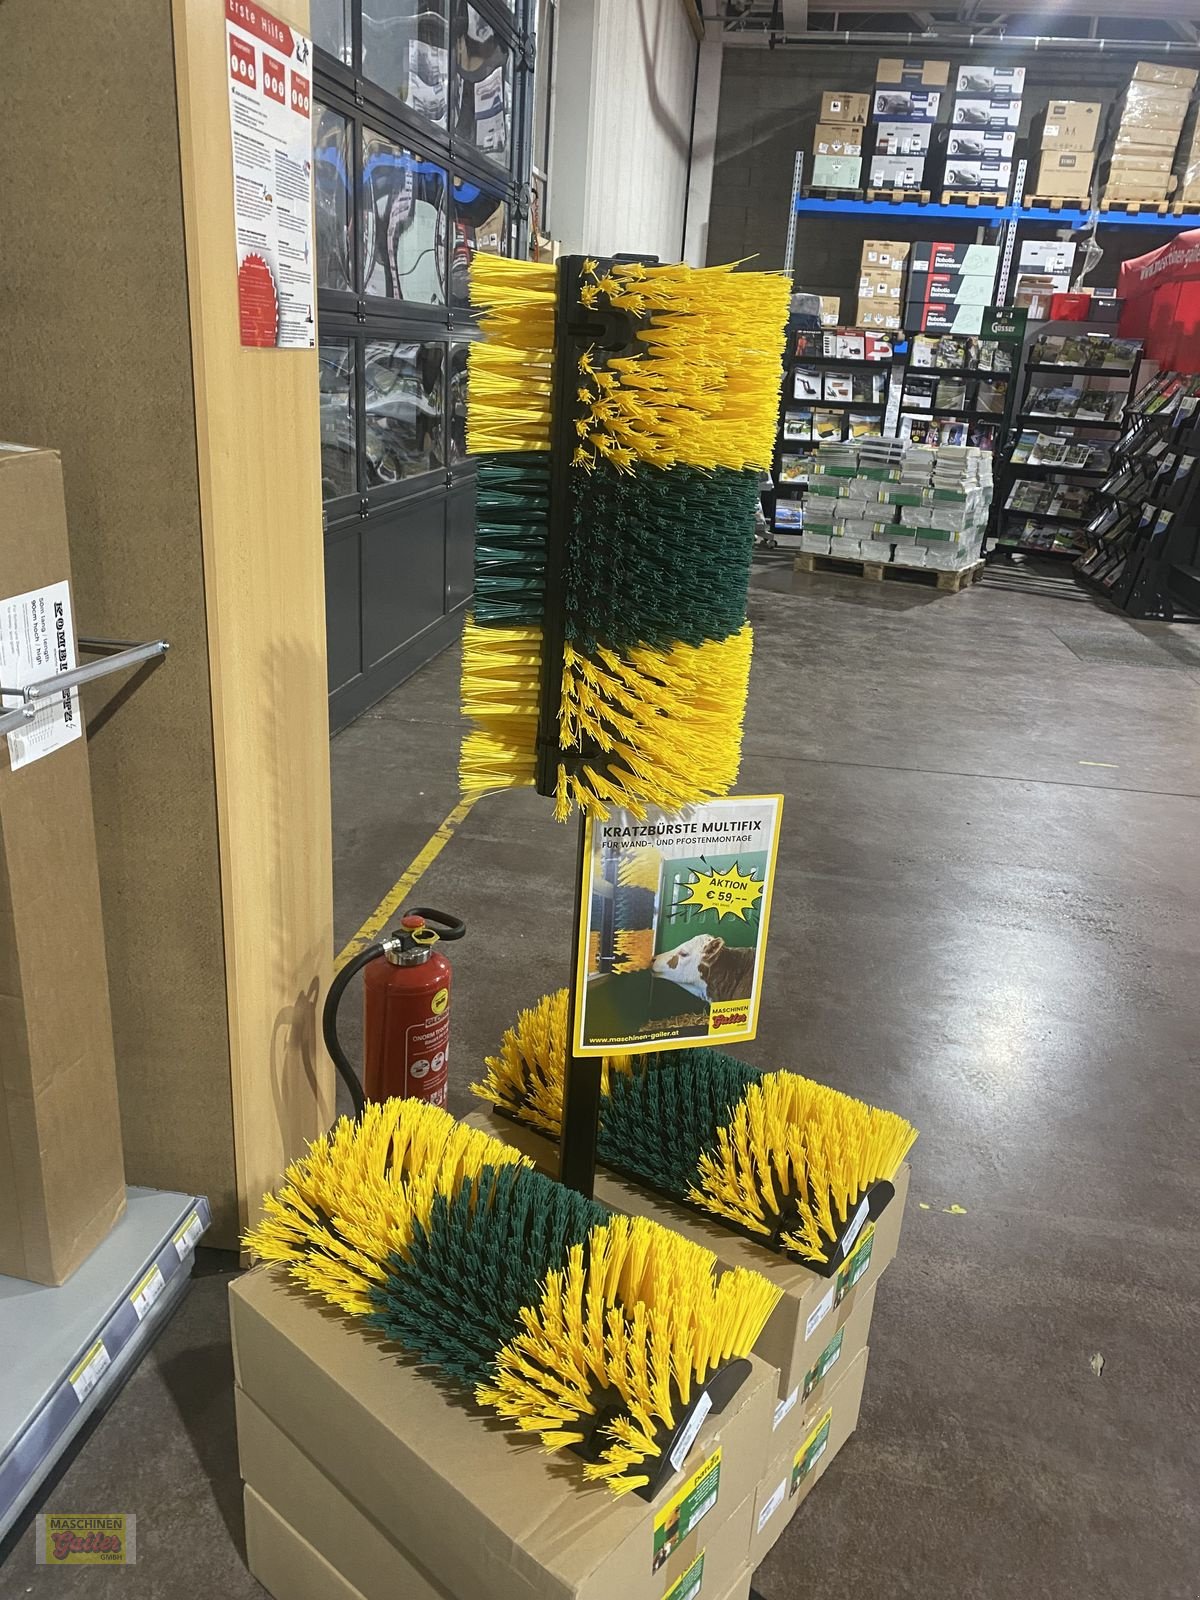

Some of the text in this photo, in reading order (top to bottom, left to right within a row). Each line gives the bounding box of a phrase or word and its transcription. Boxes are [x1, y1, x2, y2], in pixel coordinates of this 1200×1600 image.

[261, 17, 284, 43] Hilfe
[603, 820, 762, 838] KRATZBÜRSTE MULTIFIX
[602, 840, 619, 849] FÜR
[656, 838, 674, 846] UND
[676, 835, 752, 845] PFOSTENMONTAGE
[709, 878, 748, 890] AKTION
[706, 890, 716, 899] €
[712, 1005, 749, 1014] MASCHINEN
[712, 1013, 747, 1029] Gailer
[589, 1030, 679, 1044] www.maschinen-gailer.at
